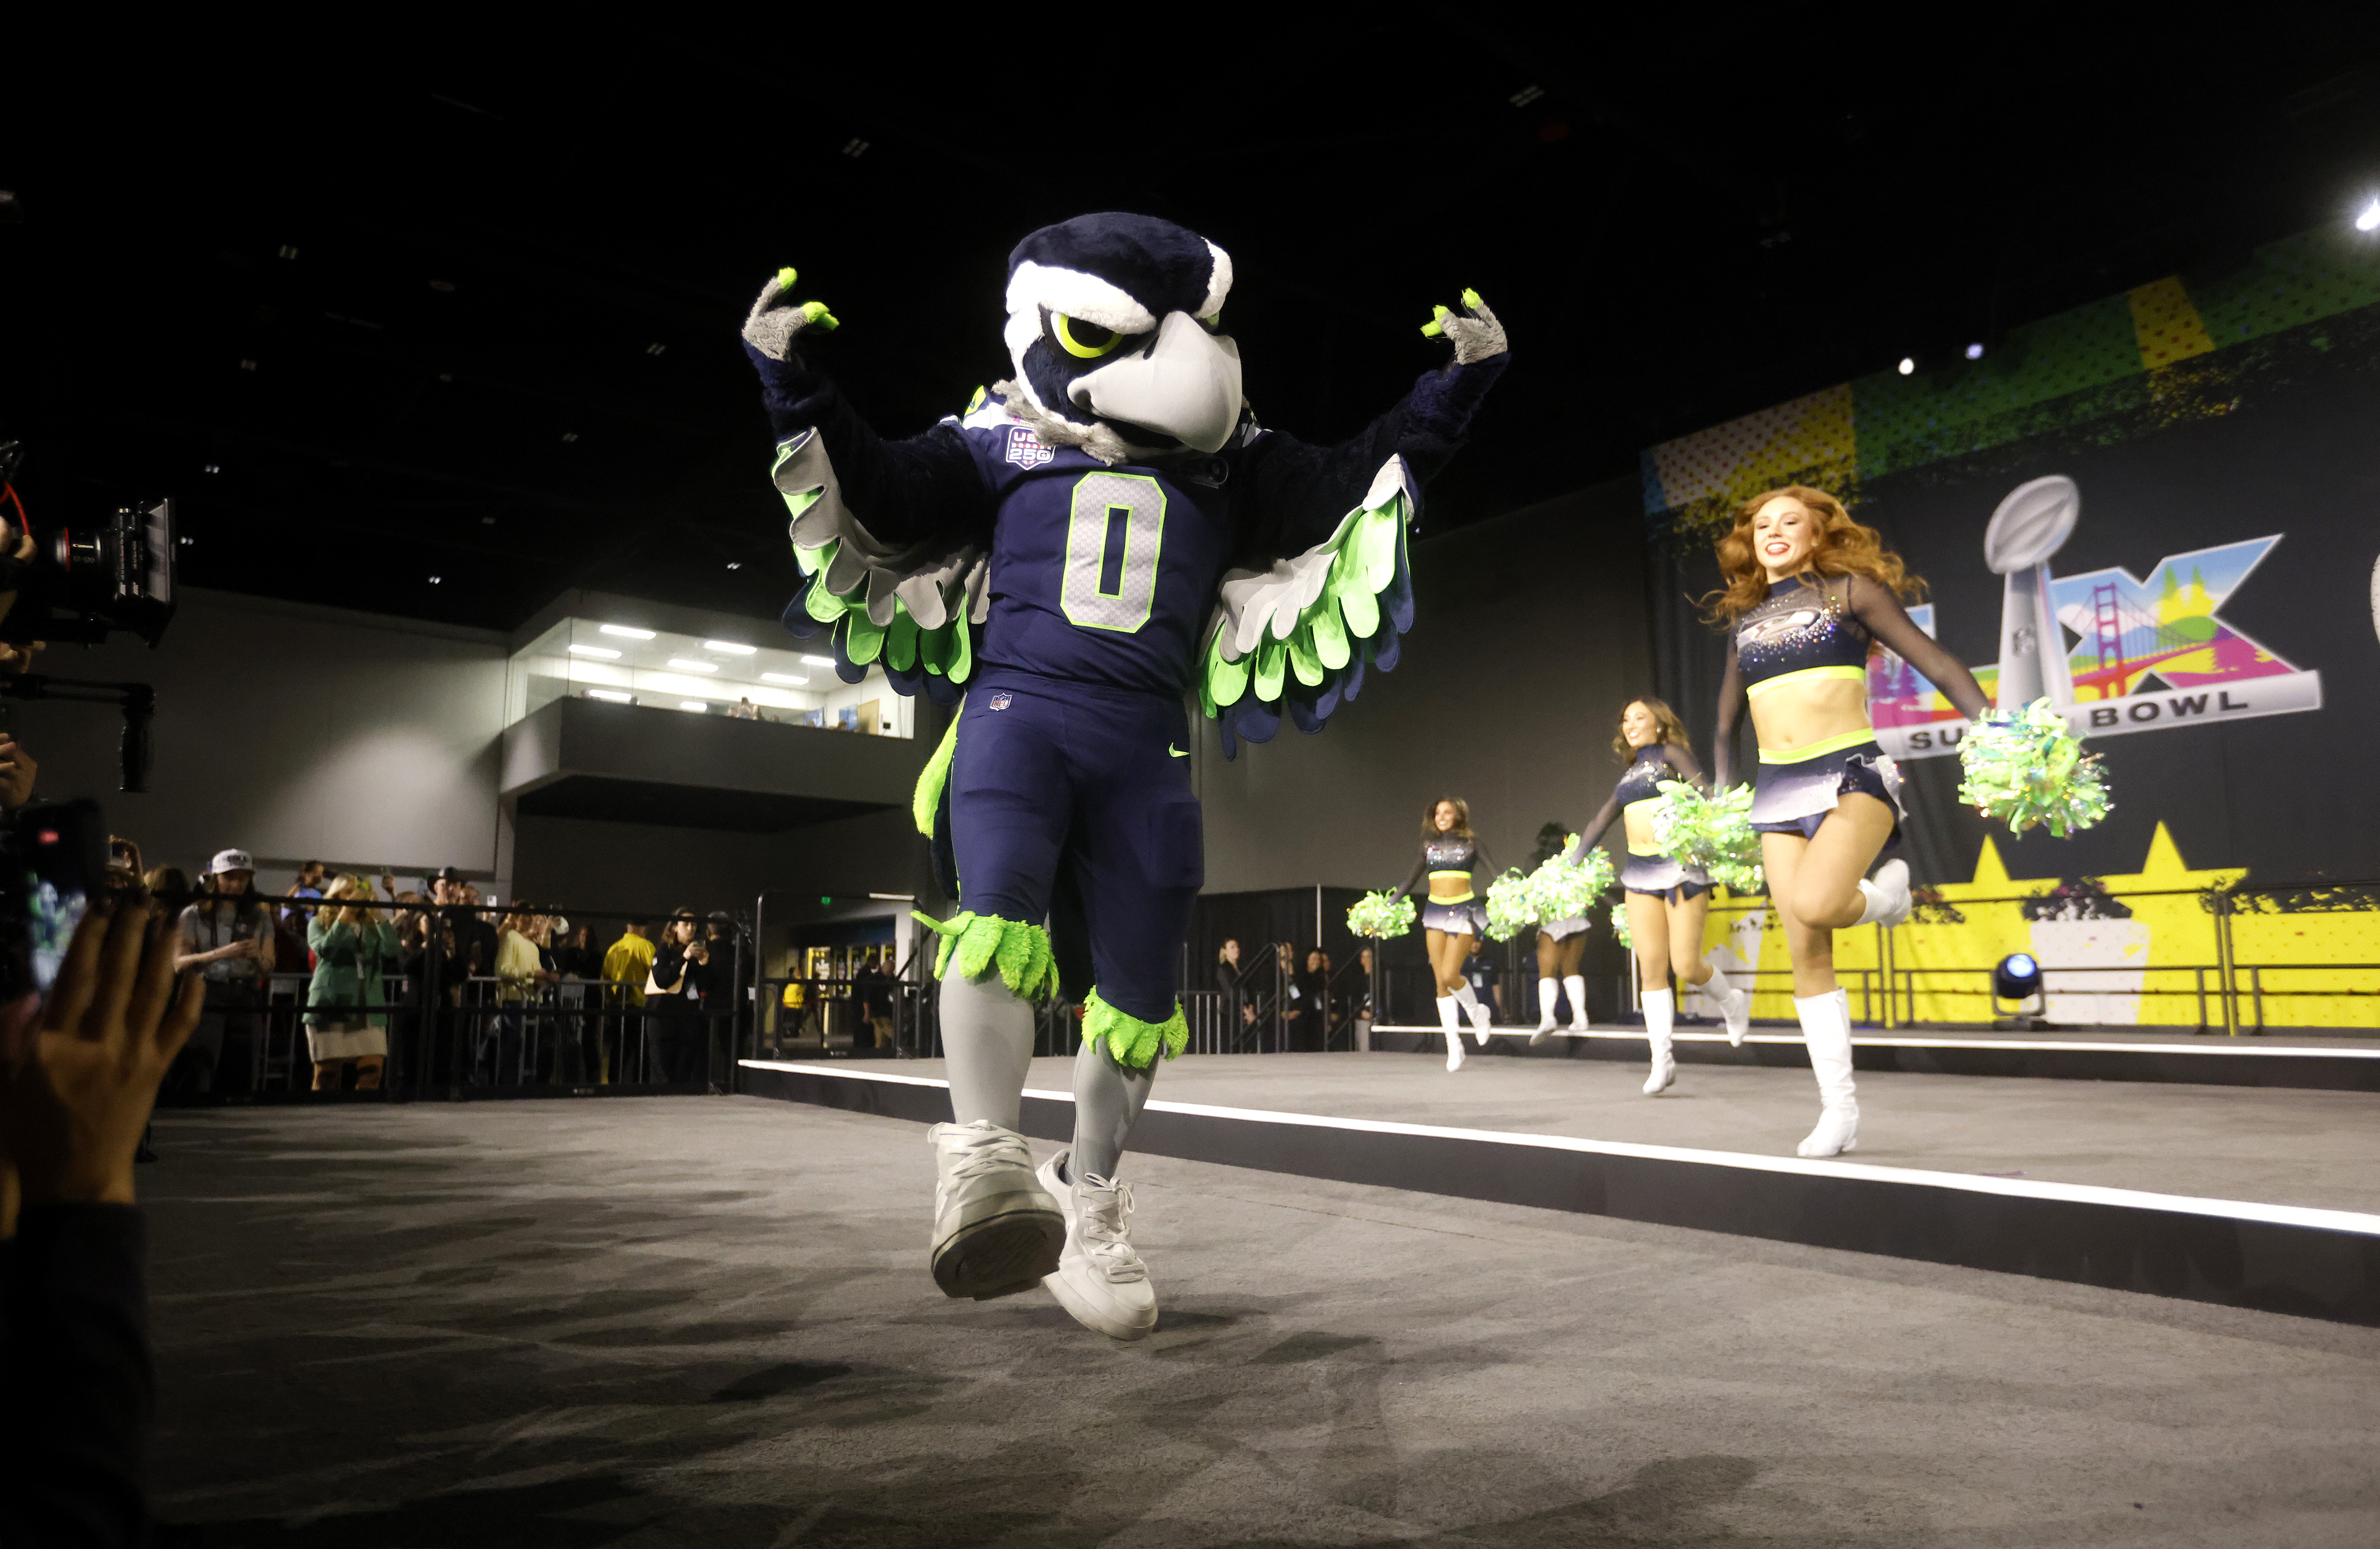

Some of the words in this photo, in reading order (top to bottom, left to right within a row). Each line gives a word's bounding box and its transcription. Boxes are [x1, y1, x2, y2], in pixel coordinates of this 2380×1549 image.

[1013, 431, 1037, 443] US
[1009, 448, 1051, 461] 250
[1060, 471, 1168, 634] 0
[2090, 691, 2249, 728] BOWL
